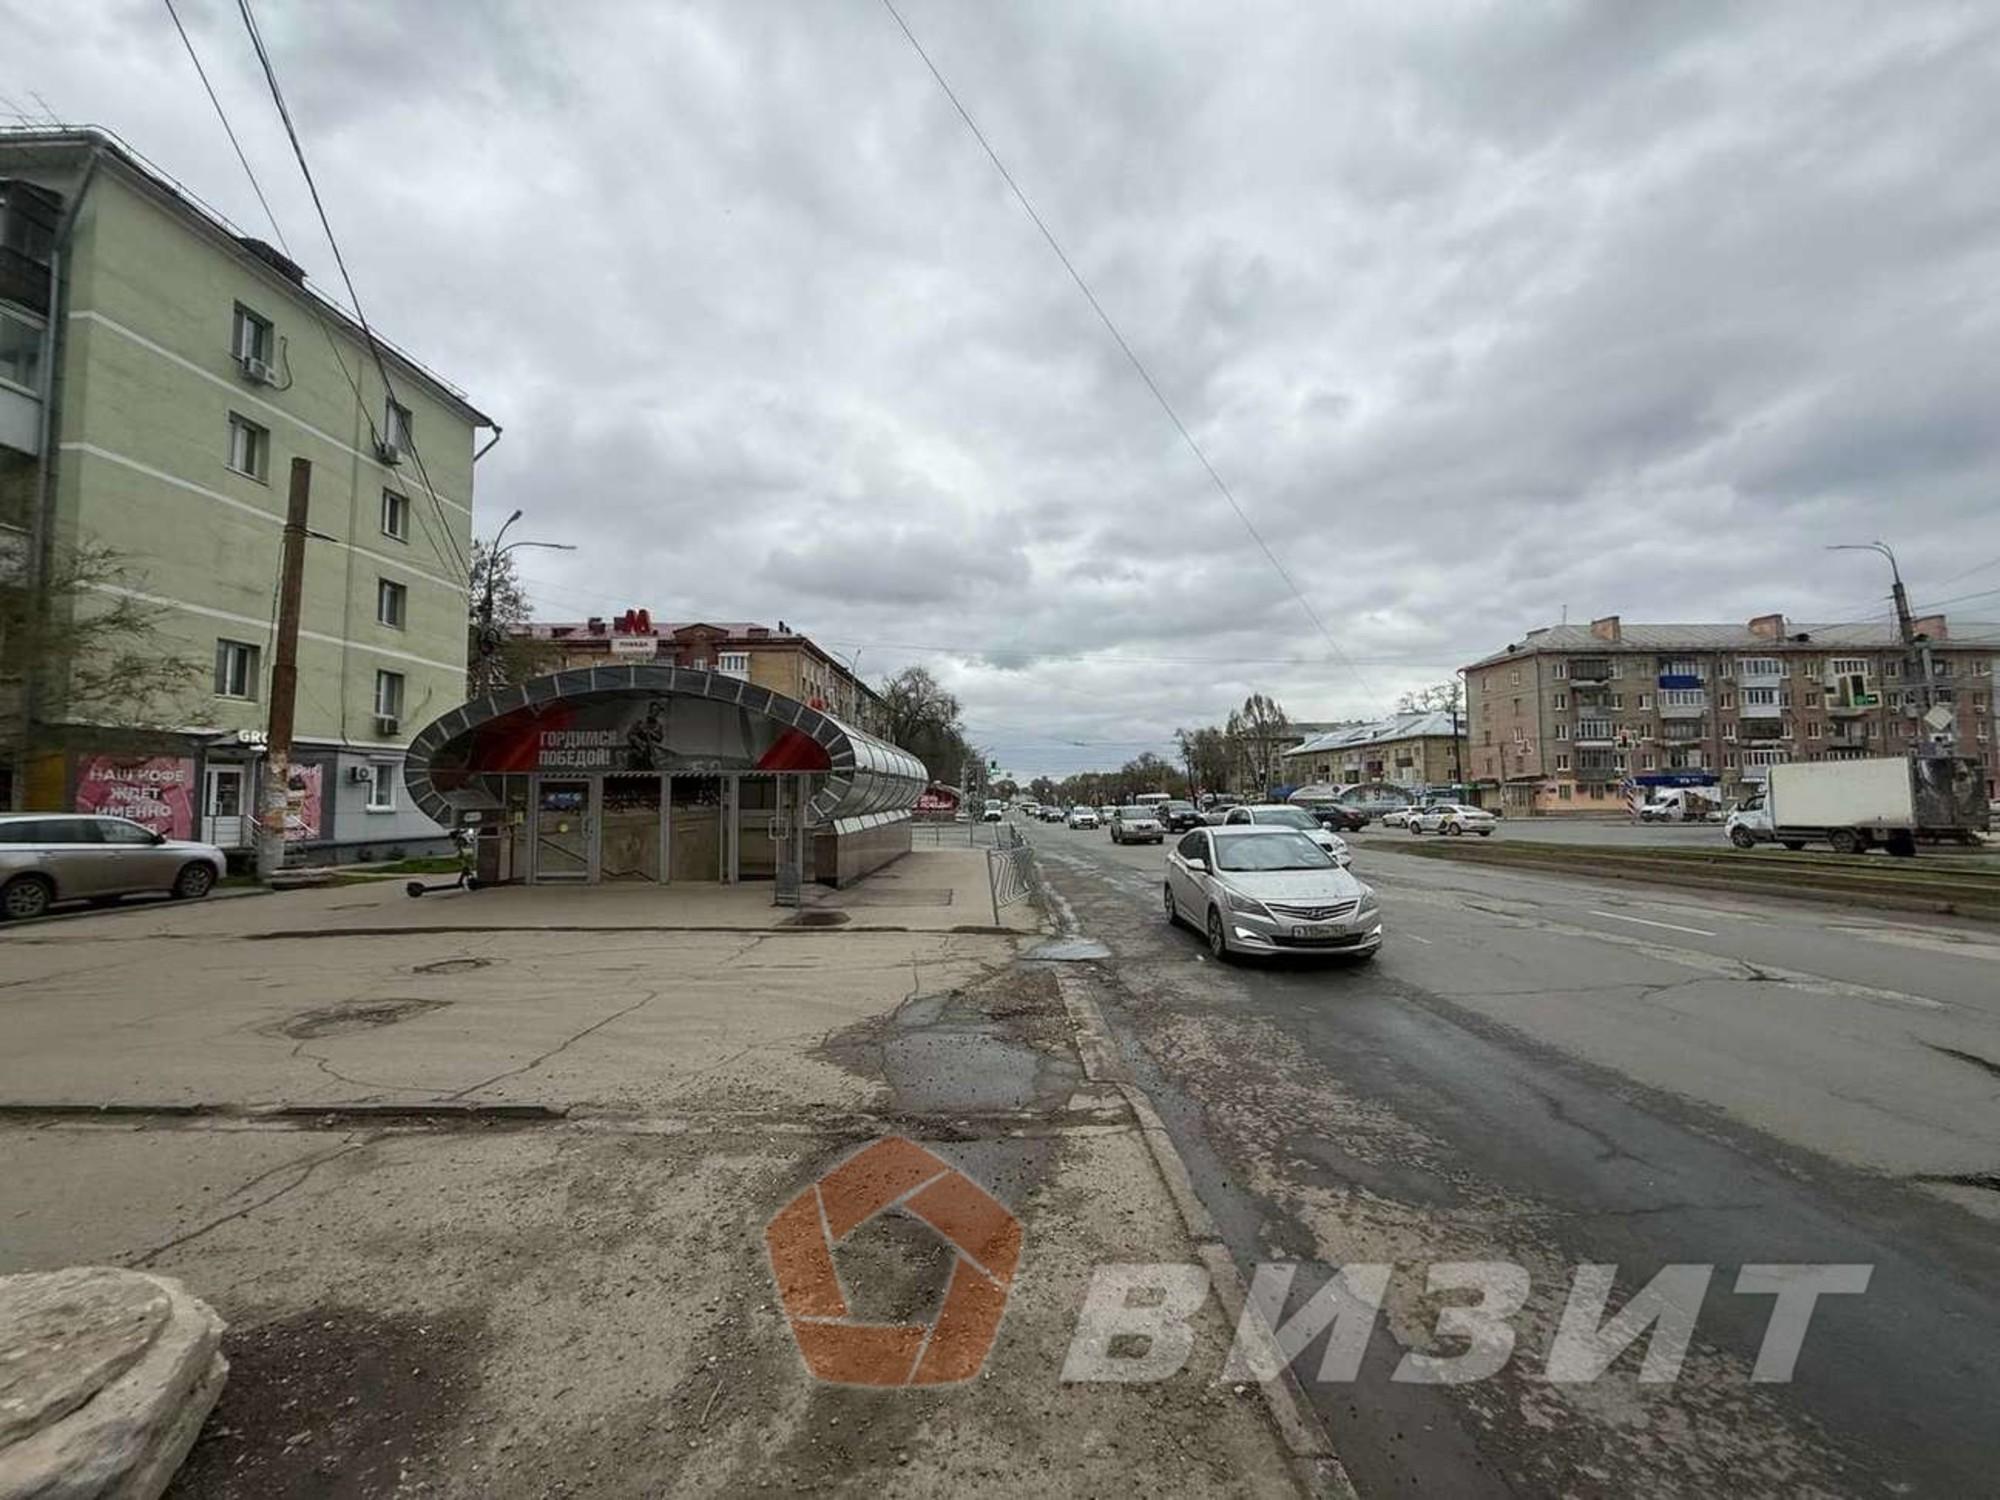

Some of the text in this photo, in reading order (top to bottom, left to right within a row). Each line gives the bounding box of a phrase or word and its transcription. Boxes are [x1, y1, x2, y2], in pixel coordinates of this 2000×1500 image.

[540, 730, 618, 748] ГОРДИМСЯ
[538, 748, 611, 768] ПОБЕДОЙ!
[89, 768, 186, 783] НАШ КОФЕ
[95, 803, 172, 818] ИМЕННО
